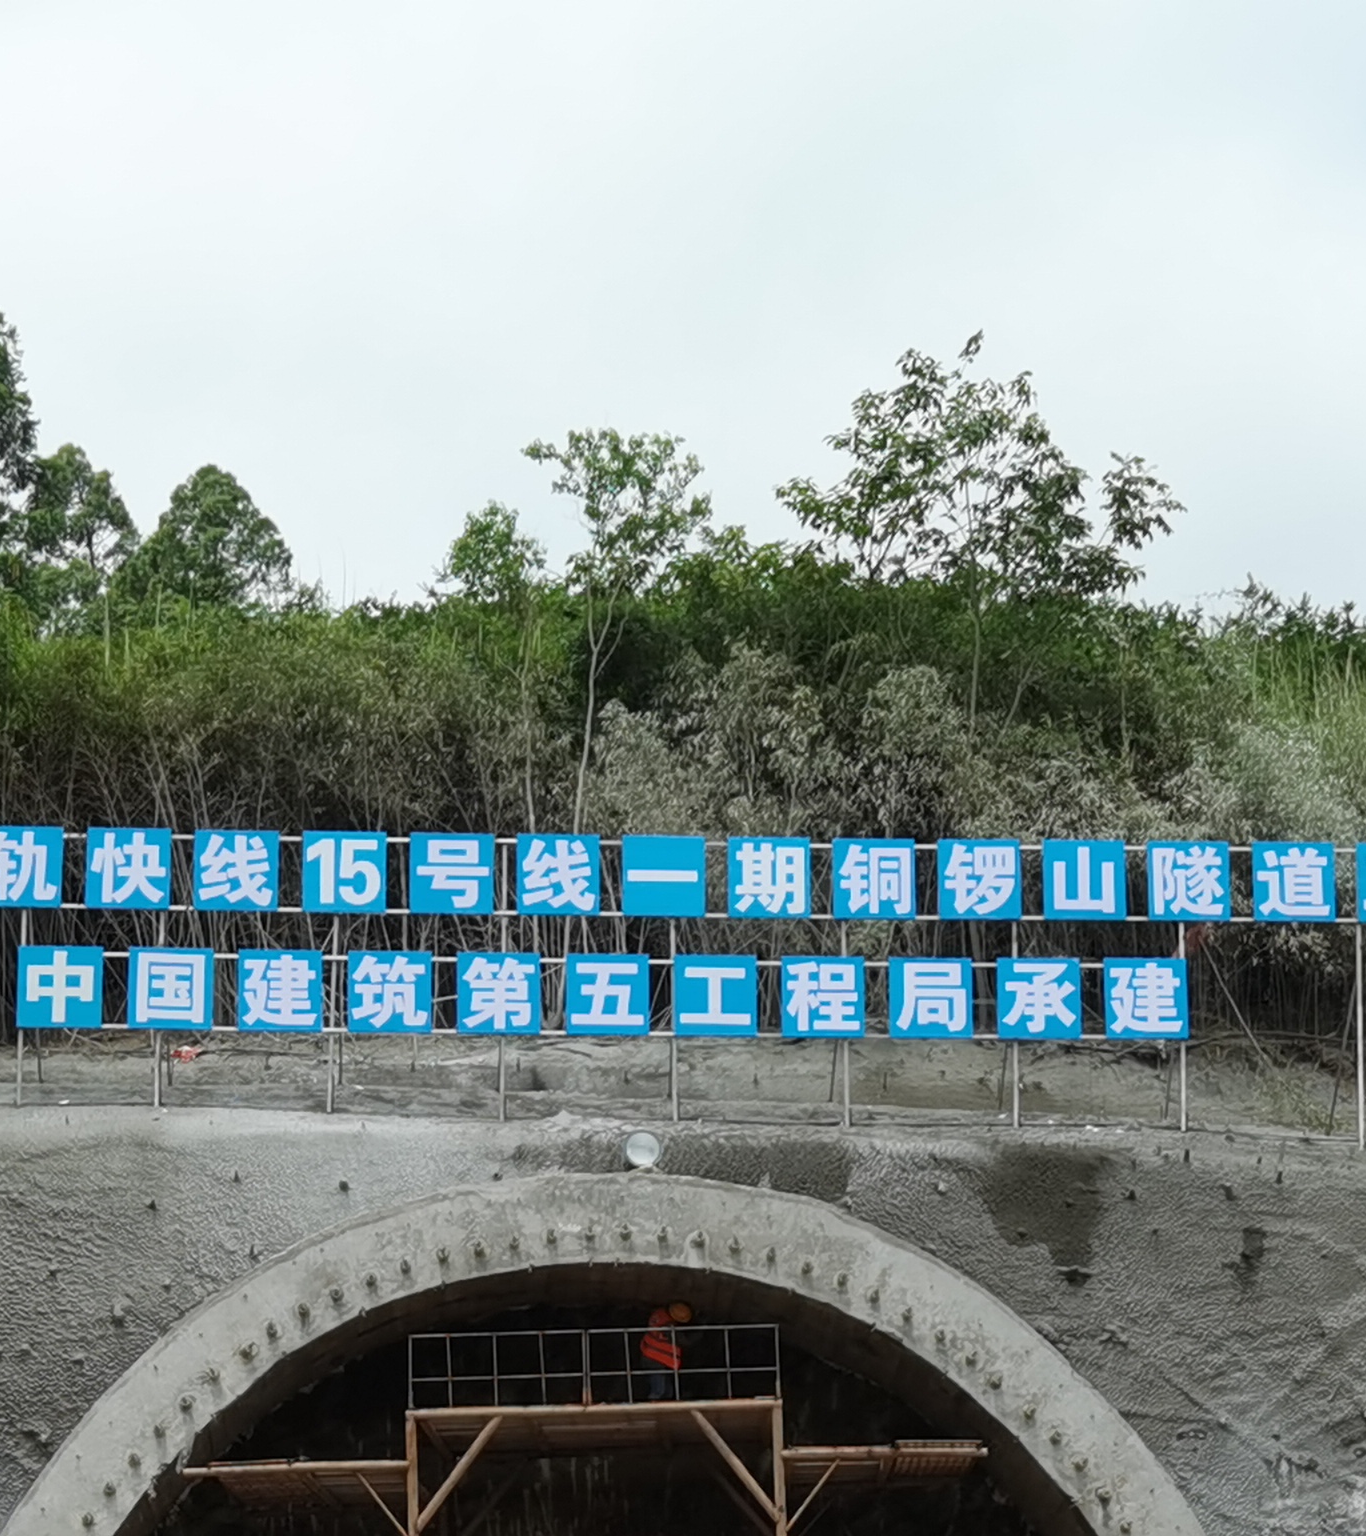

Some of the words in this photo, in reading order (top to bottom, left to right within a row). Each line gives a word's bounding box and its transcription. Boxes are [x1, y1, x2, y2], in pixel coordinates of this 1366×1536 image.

[25, 950, 1185, 1034] 中国建筑第五工程局承建
